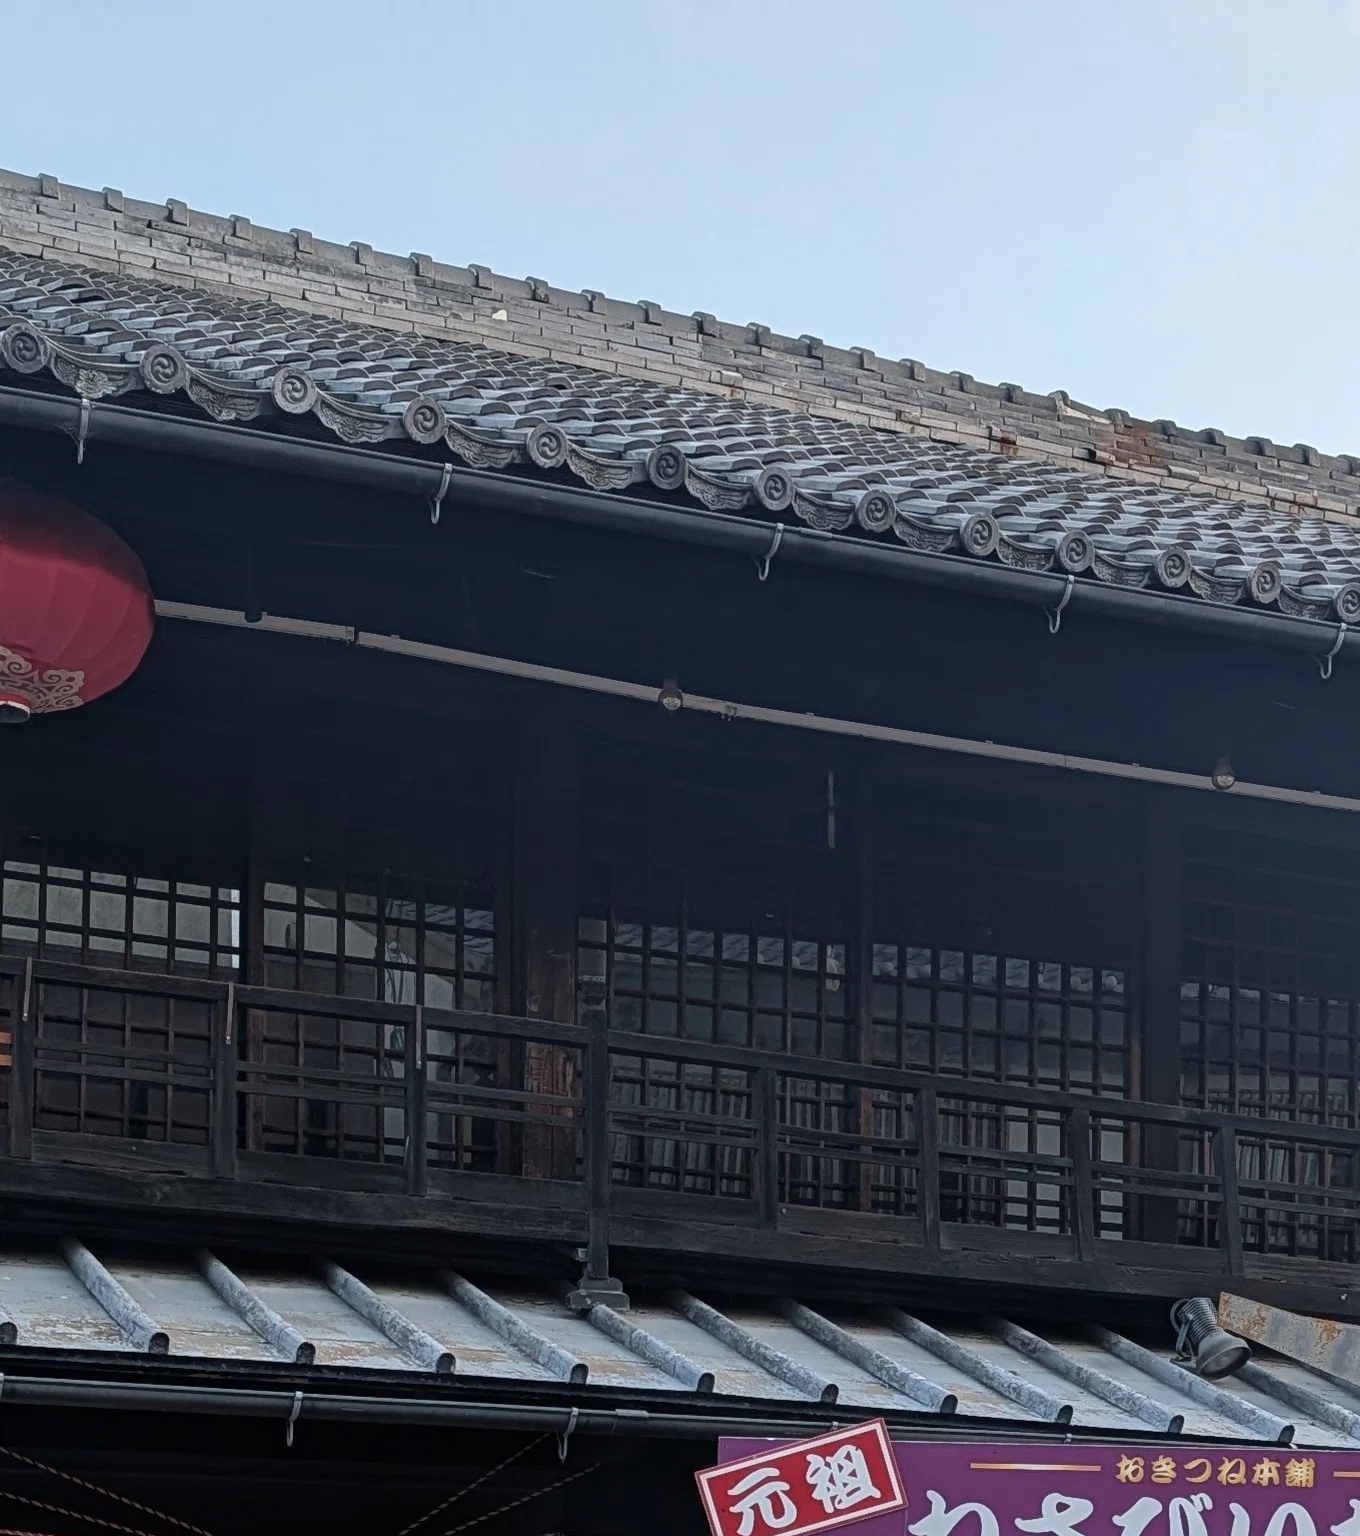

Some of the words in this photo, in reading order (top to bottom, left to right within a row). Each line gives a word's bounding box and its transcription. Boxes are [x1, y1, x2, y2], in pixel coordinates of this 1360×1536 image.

[726, 1444, 881, 1536] 元祖
[1115, 1453, 1316, 1488] おきつね本舗
